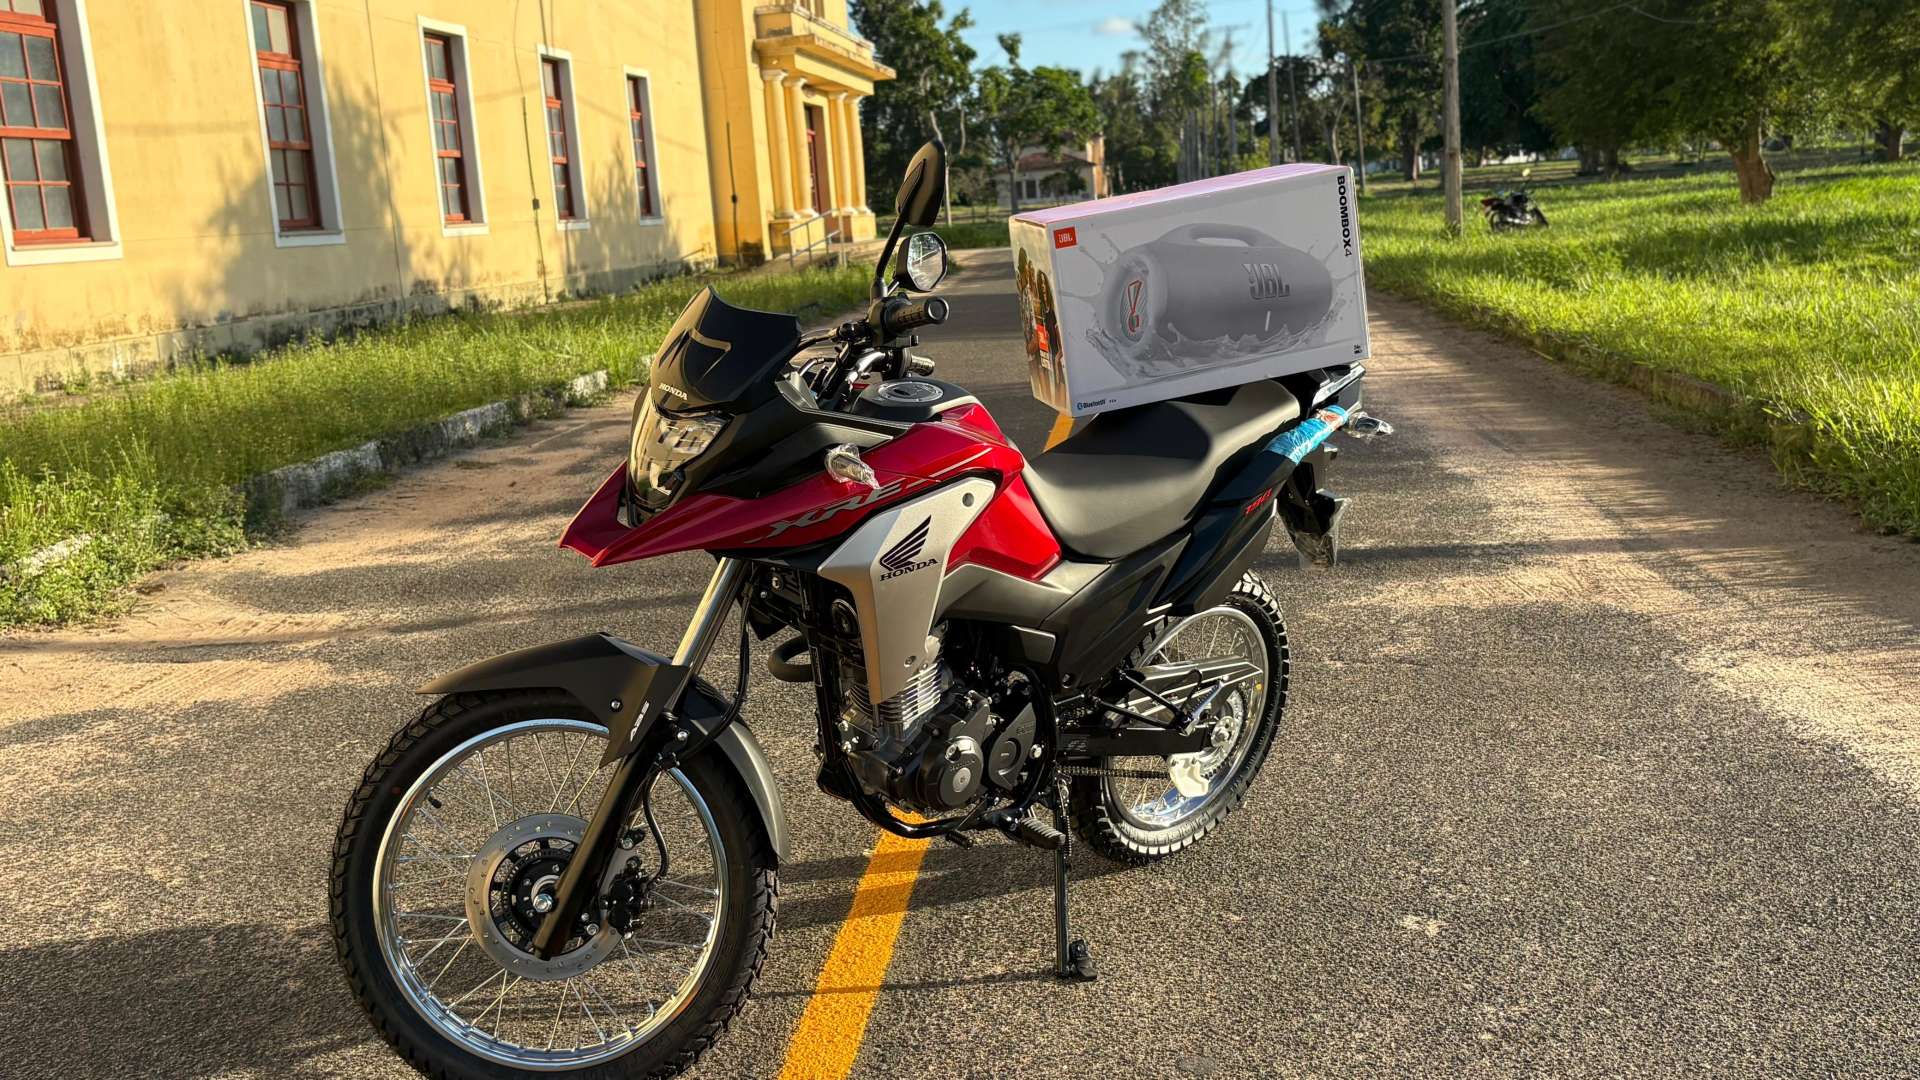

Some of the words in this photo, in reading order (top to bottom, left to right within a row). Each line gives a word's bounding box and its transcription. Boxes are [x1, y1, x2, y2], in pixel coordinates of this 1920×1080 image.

[1058, 232, 1074, 244] JBL
[1243, 263, 1290, 301] JBL
[658, 382, 688, 401] HONDA
[765, 478, 906, 538] XRE
[880, 558, 938, 581] HONDA
